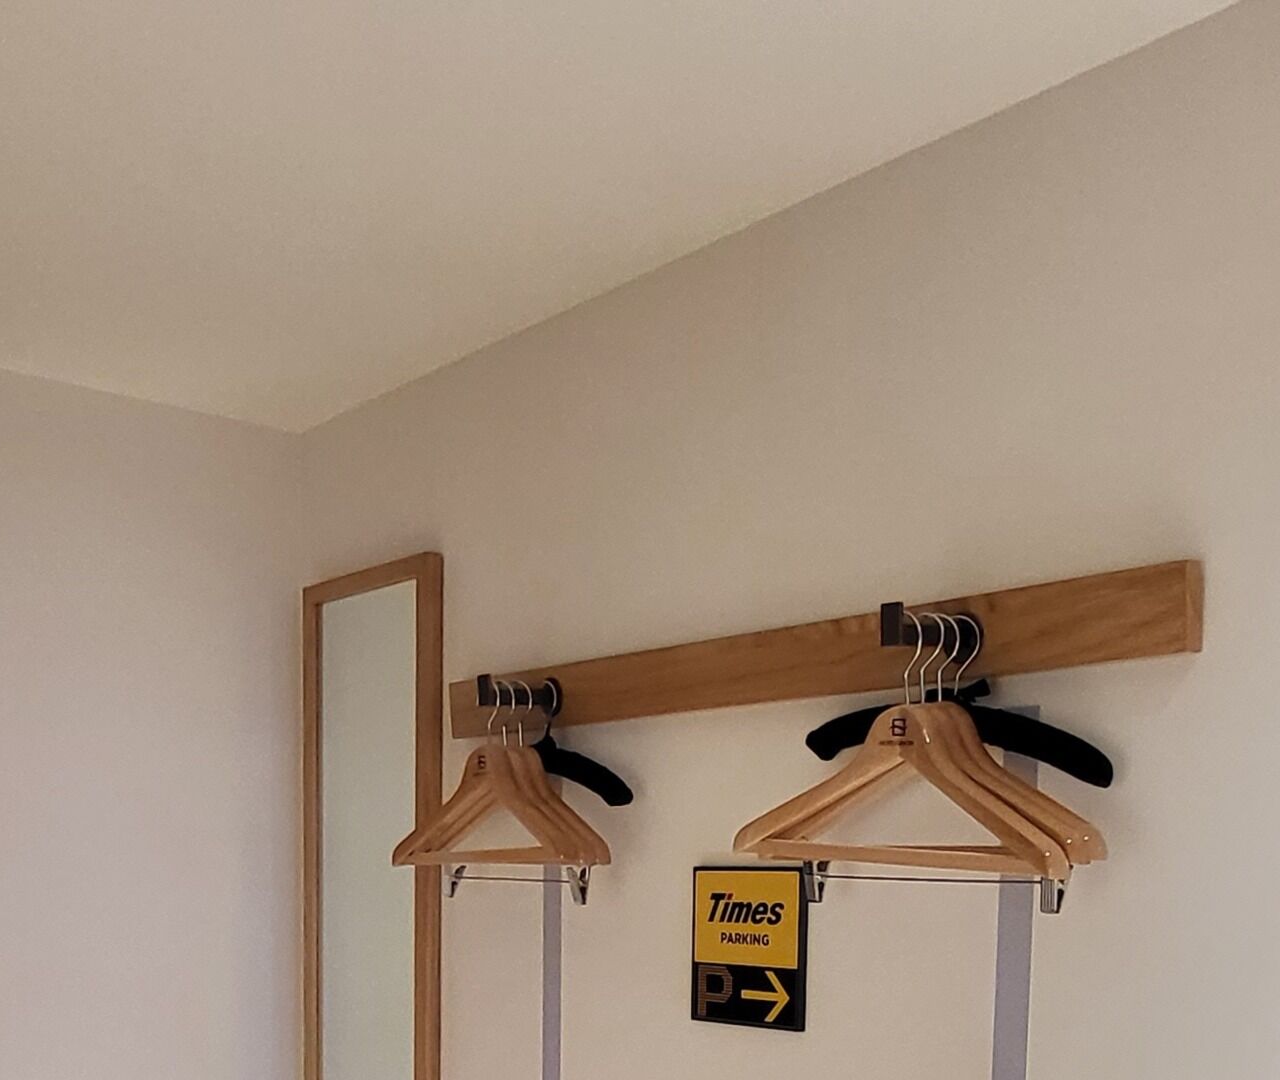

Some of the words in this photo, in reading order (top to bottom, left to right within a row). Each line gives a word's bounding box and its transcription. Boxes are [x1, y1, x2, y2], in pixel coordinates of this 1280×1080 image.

[706, 891, 785, 927] Times
[719, 931, 770, 948] PARKING
[697, 964, 734, 1018] P
